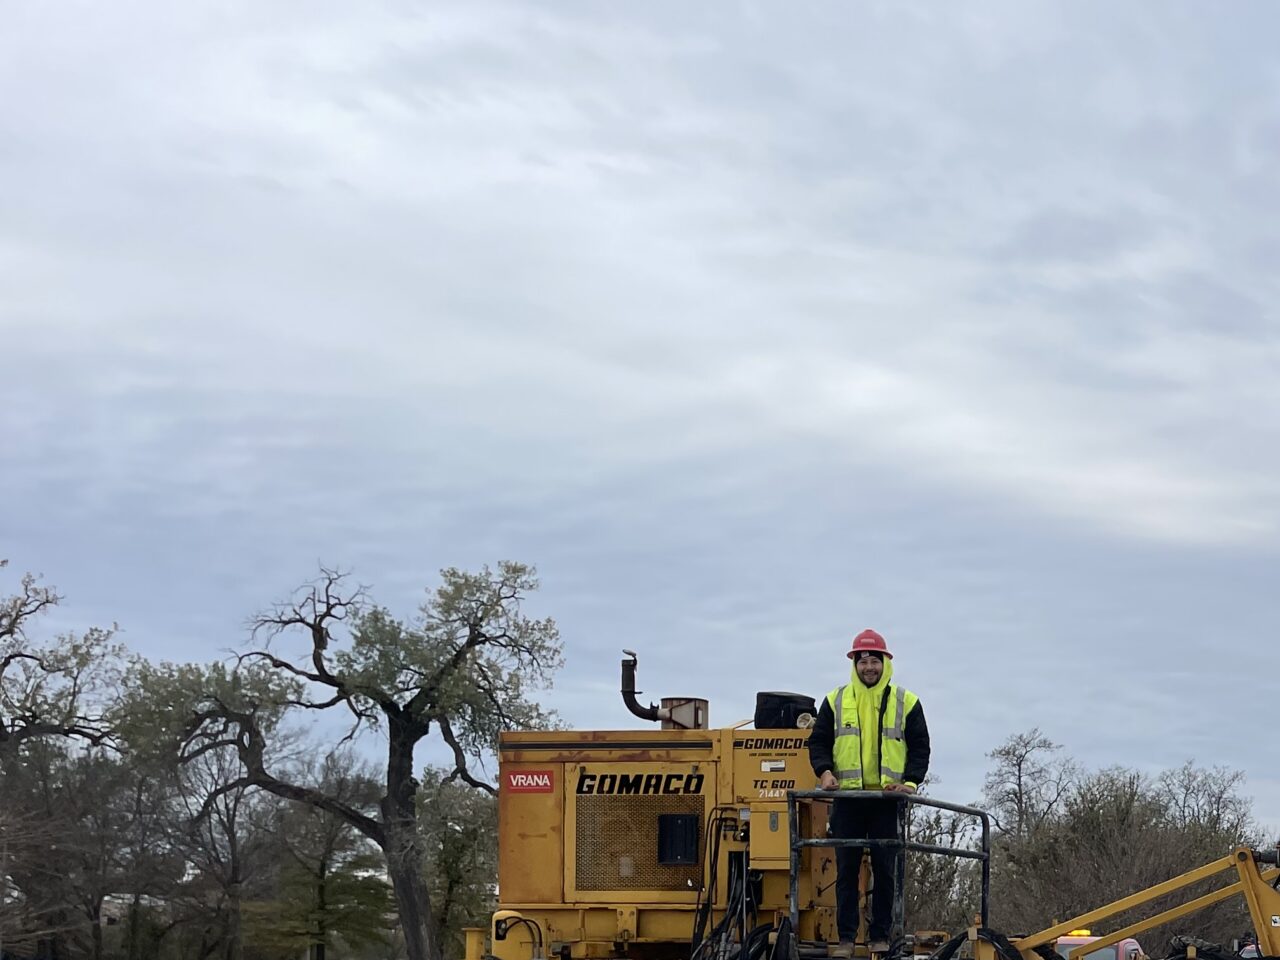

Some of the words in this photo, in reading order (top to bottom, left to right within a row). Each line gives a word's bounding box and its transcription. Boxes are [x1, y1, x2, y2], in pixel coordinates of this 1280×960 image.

[744, 738, 803, 749] GOMACO
[510, 774, 550, 786] VRANA
[576, 774, 704, 794] GOMACO
[753, 779, 768, 789] TC
[771, 779, 795, 789] 600
